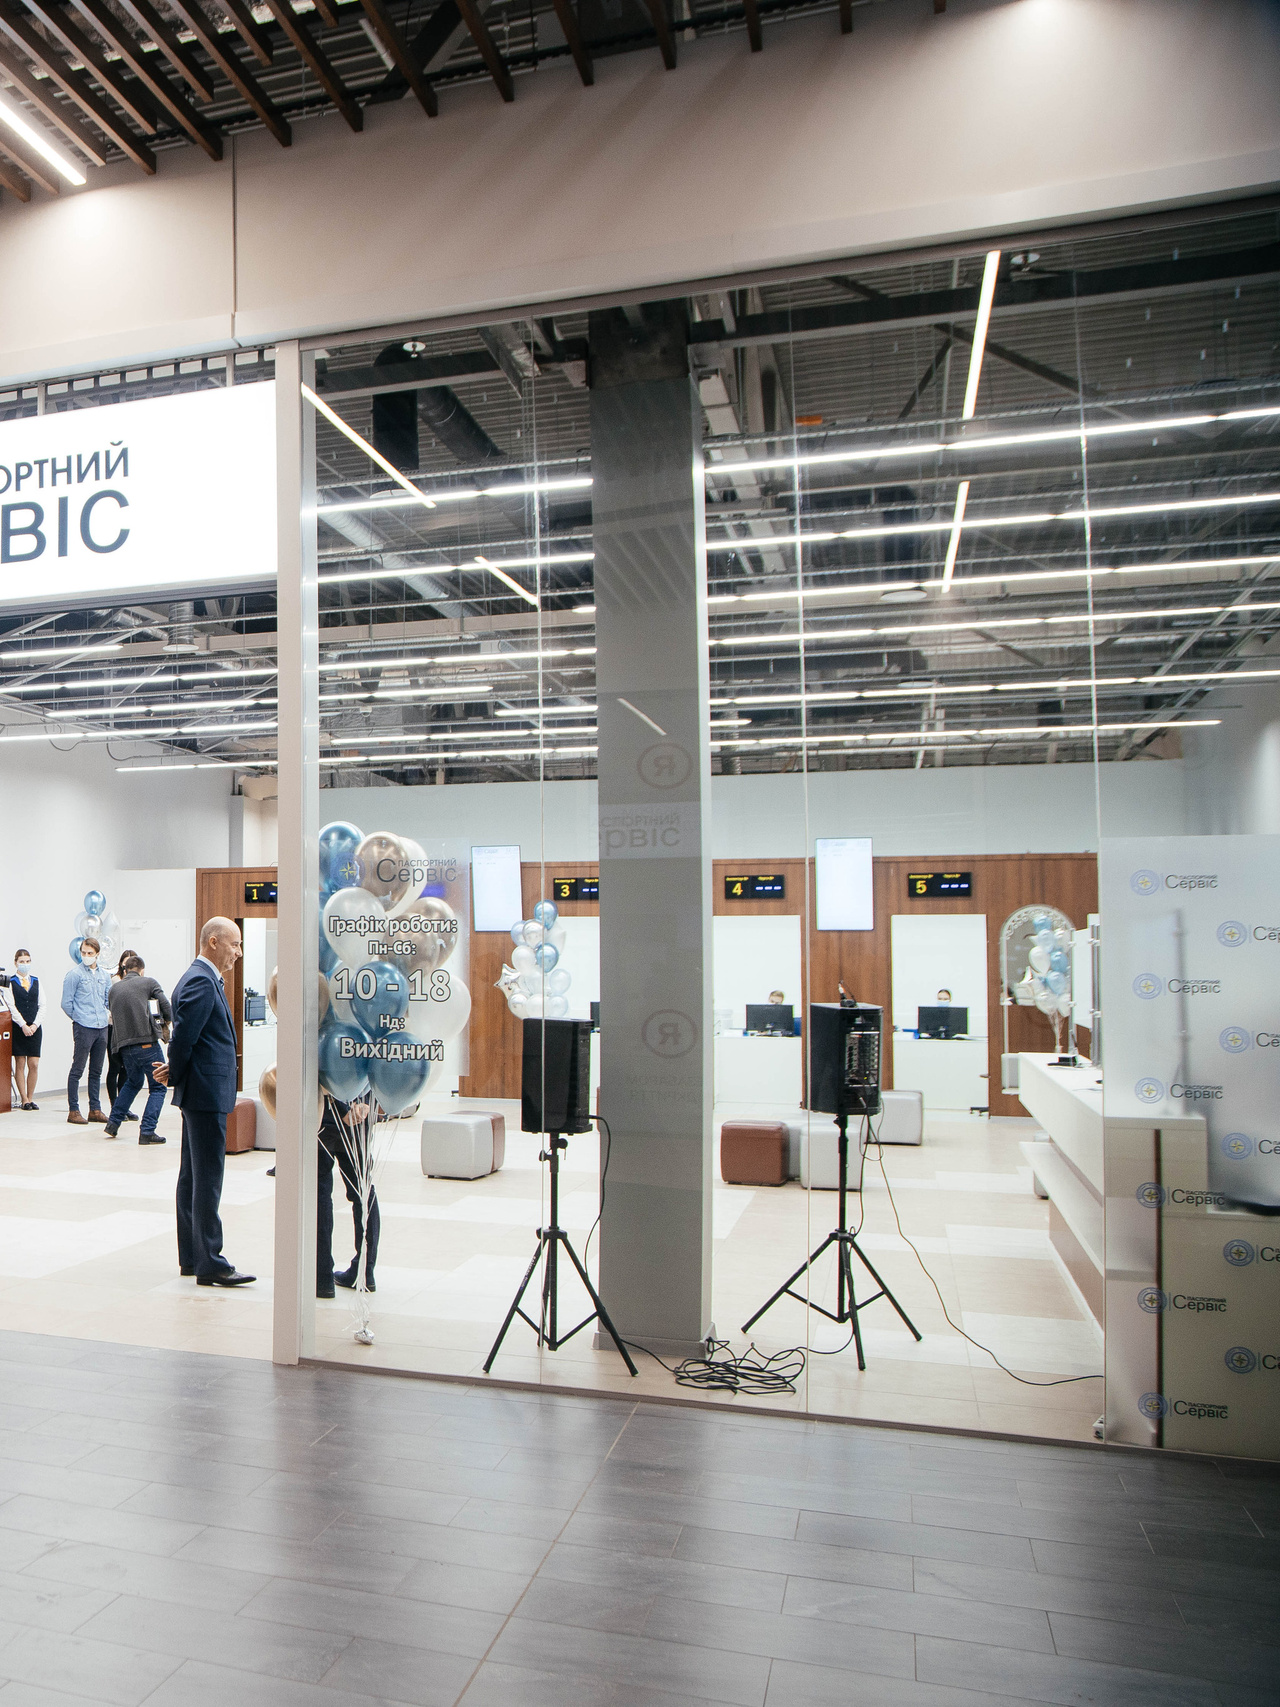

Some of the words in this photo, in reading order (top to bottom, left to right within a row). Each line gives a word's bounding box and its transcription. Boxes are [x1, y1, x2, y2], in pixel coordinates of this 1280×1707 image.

[398, 858, 456, 866] ПАСПОРТНИЙ
[376, 858, 456, 886] Сервіс
[732, 882, 744, 896] 4
[916, 880, 927, 894] 5
[1165, 874, 1218, 890] Сервіс
[252, 888, 258, 900] 1
[560, 884, 570, 898] 3
[329, 916, 385, 936] Графік
[389, 915, 458, 936] роботи:
[368, 941, 416, 955] Пн-Сб:
[334, 968, 377, 1000] 10
[408, 969, 451, 1002] 18
[1168, 979, 1220, 995] Сервіс
[379, 1014, 406, 1030] Нд:
[340, 1037, 444, 1062] Вихідний
[1170, 1084, 1223, 1101] Сервіс
[1171, 1189, 1225, 1206] Сервіс
[1173, 1295, 1227, 1313] Сервіс
[1174, 1400, 1228, 1419] Сервіс
